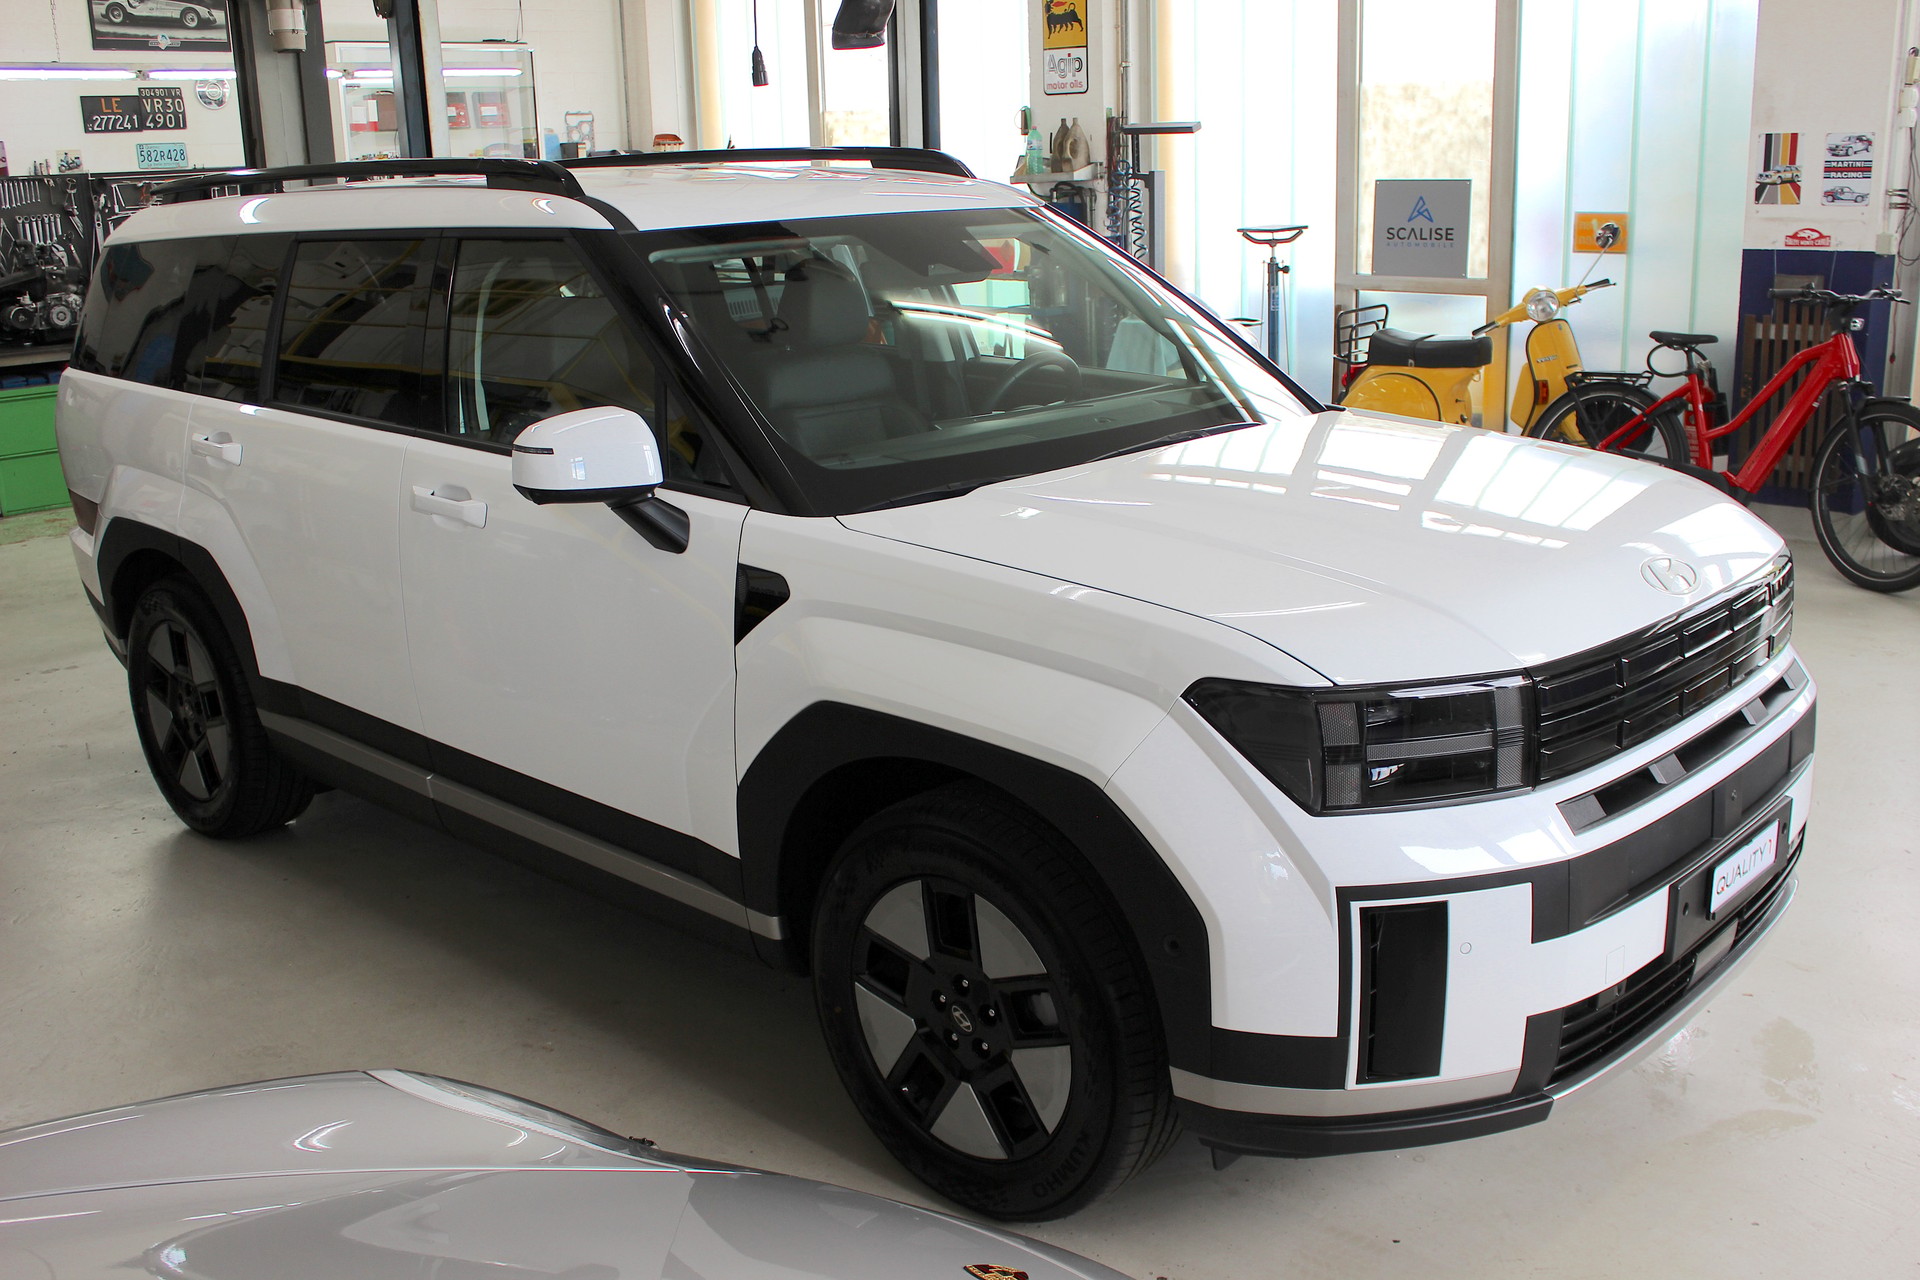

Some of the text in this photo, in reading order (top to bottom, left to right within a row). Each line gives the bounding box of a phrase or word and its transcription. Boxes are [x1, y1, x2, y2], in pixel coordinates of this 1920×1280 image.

[1047, 53, 1083, 79] Agip
[140, 88, 181, 97] 304901 VR
[1047, 80, 1083, 90] motor oils
[101, 98, 122, 113] LE
[142, 98, 184, 113] VR30
[93, 114, 138, 131] 277241
[145, 113, 184, 129] 4901
[140, 148, 186, 163] 582R428
[1386, 227, 1455, 241] SCALISE
[1716, 842, 1767, 895] QUALITY
